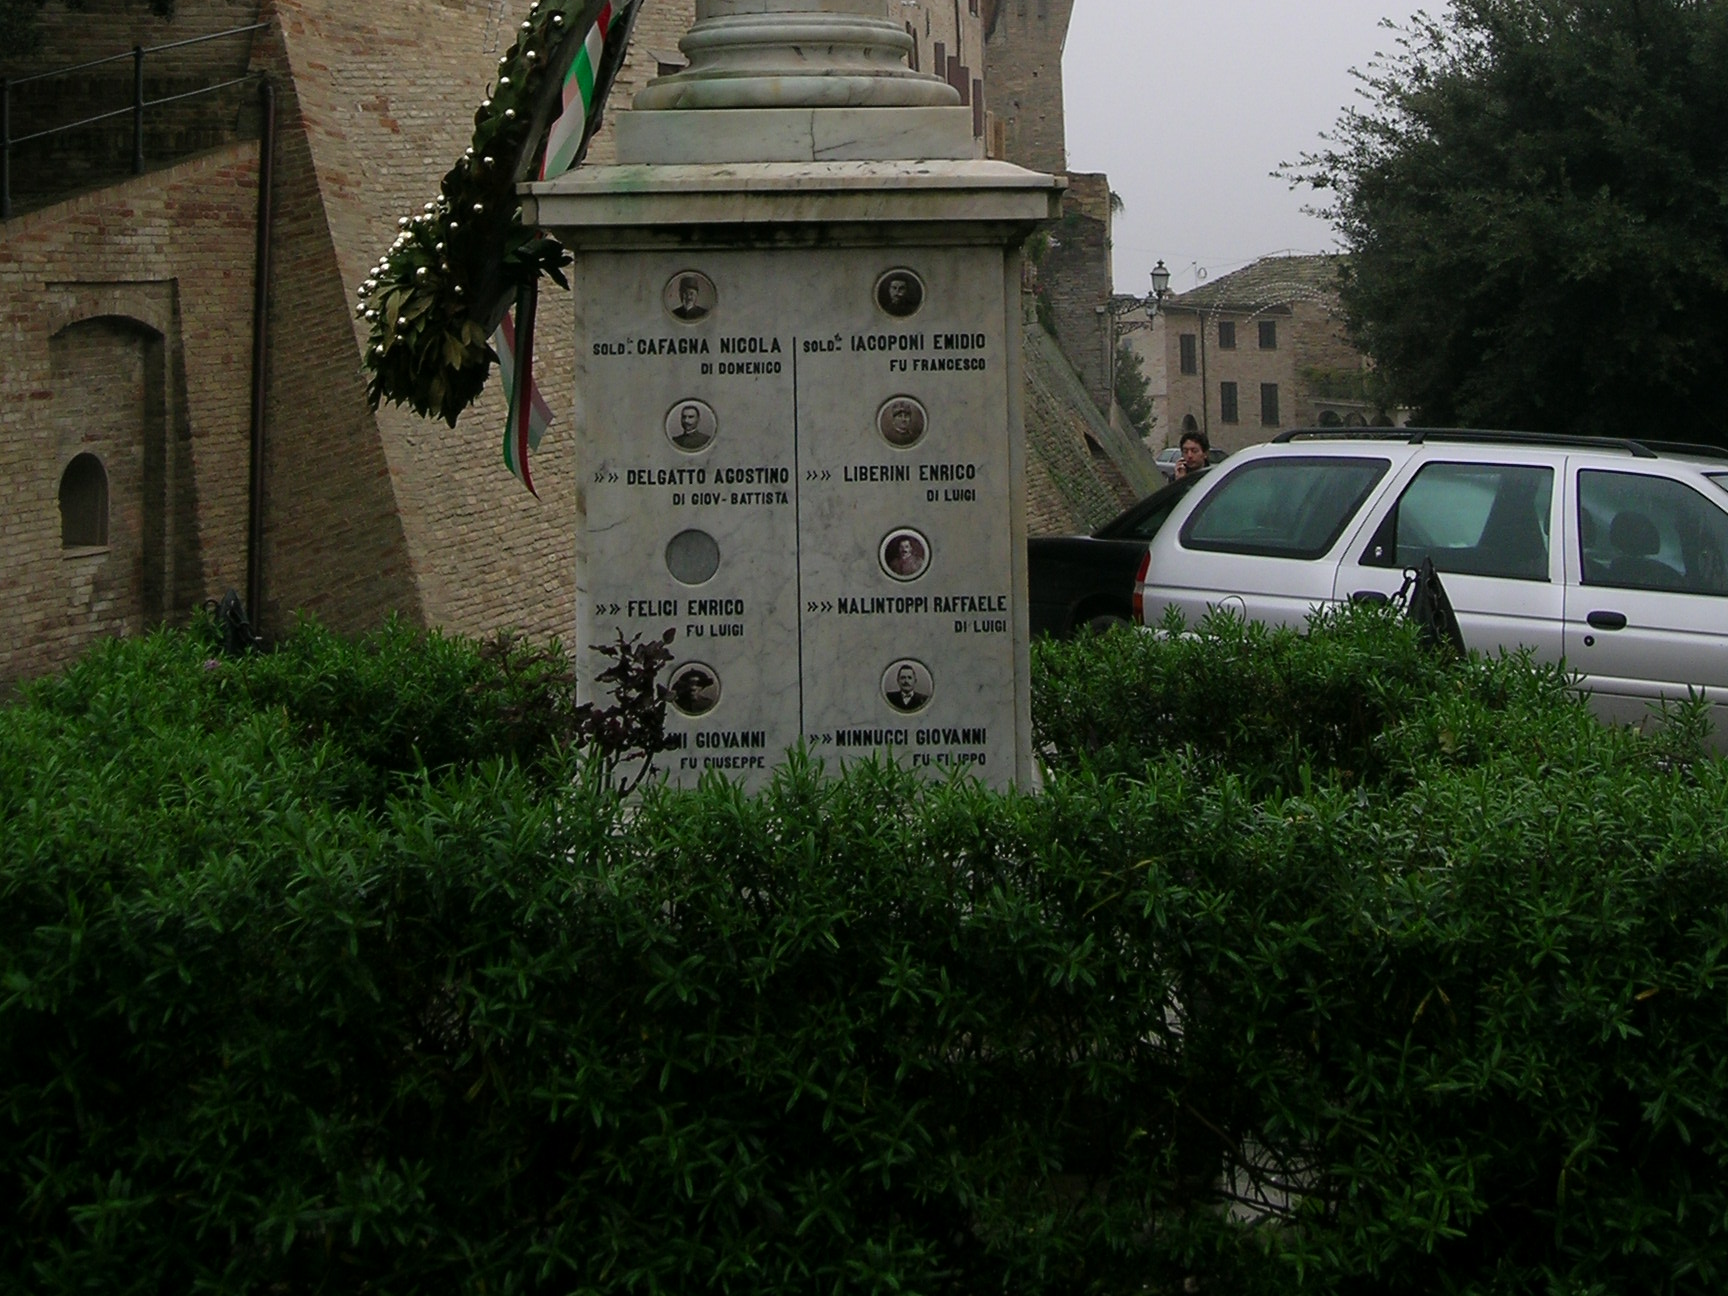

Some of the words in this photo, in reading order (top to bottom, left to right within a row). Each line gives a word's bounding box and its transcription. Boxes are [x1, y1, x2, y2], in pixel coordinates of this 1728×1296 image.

[637, 338, 710, 355] CAFAGNA
[720, 337, 782, 354] NICOLA
[851, 334, 924, 352] IACOPONI
[933, 333, 986, 350] EMIDIO
[701, 363, 713, 375] DI
[719, 361, 782, 375] DOMENICO
[890, 359, 907, 372] FU
[913, 358, 986, 371] FRANCESCO
[627, 469, 706, 485] DELGATTO
[714, 468, 789, 484] AGOSTINO
[844, 465, 910, 482] LIBERINI
[919, 464, 976, 481] ENRICO
[672, 493, 685, 505] DI
[731, 492, 789, 505] BATTISTA
[926, 489, 939, 502] DI
[944, 489, 976, 502] LUIGI
[628, 600, 678, 617] FELICI
[688, 599, 744, 616] ENRICO
[838, 597, 928, 614] MALINTOPPI
[933, 596, 1007, 612] RAFFAELE
[686, 624, 704, 637] FU
[710, 624, 744, 637] LUIGI
[954, 620, 967, 633] DI
[973, 620, 1007, 633] LUIGI
[696, 731, 766, 749] GIOVANNI
[836, 729, 908, 747] MINNUCCI
[916, 728, 987, 745] GIOVANNI
[680, 757, 698, 770] FU
[913, 753, 930, 766] FU
